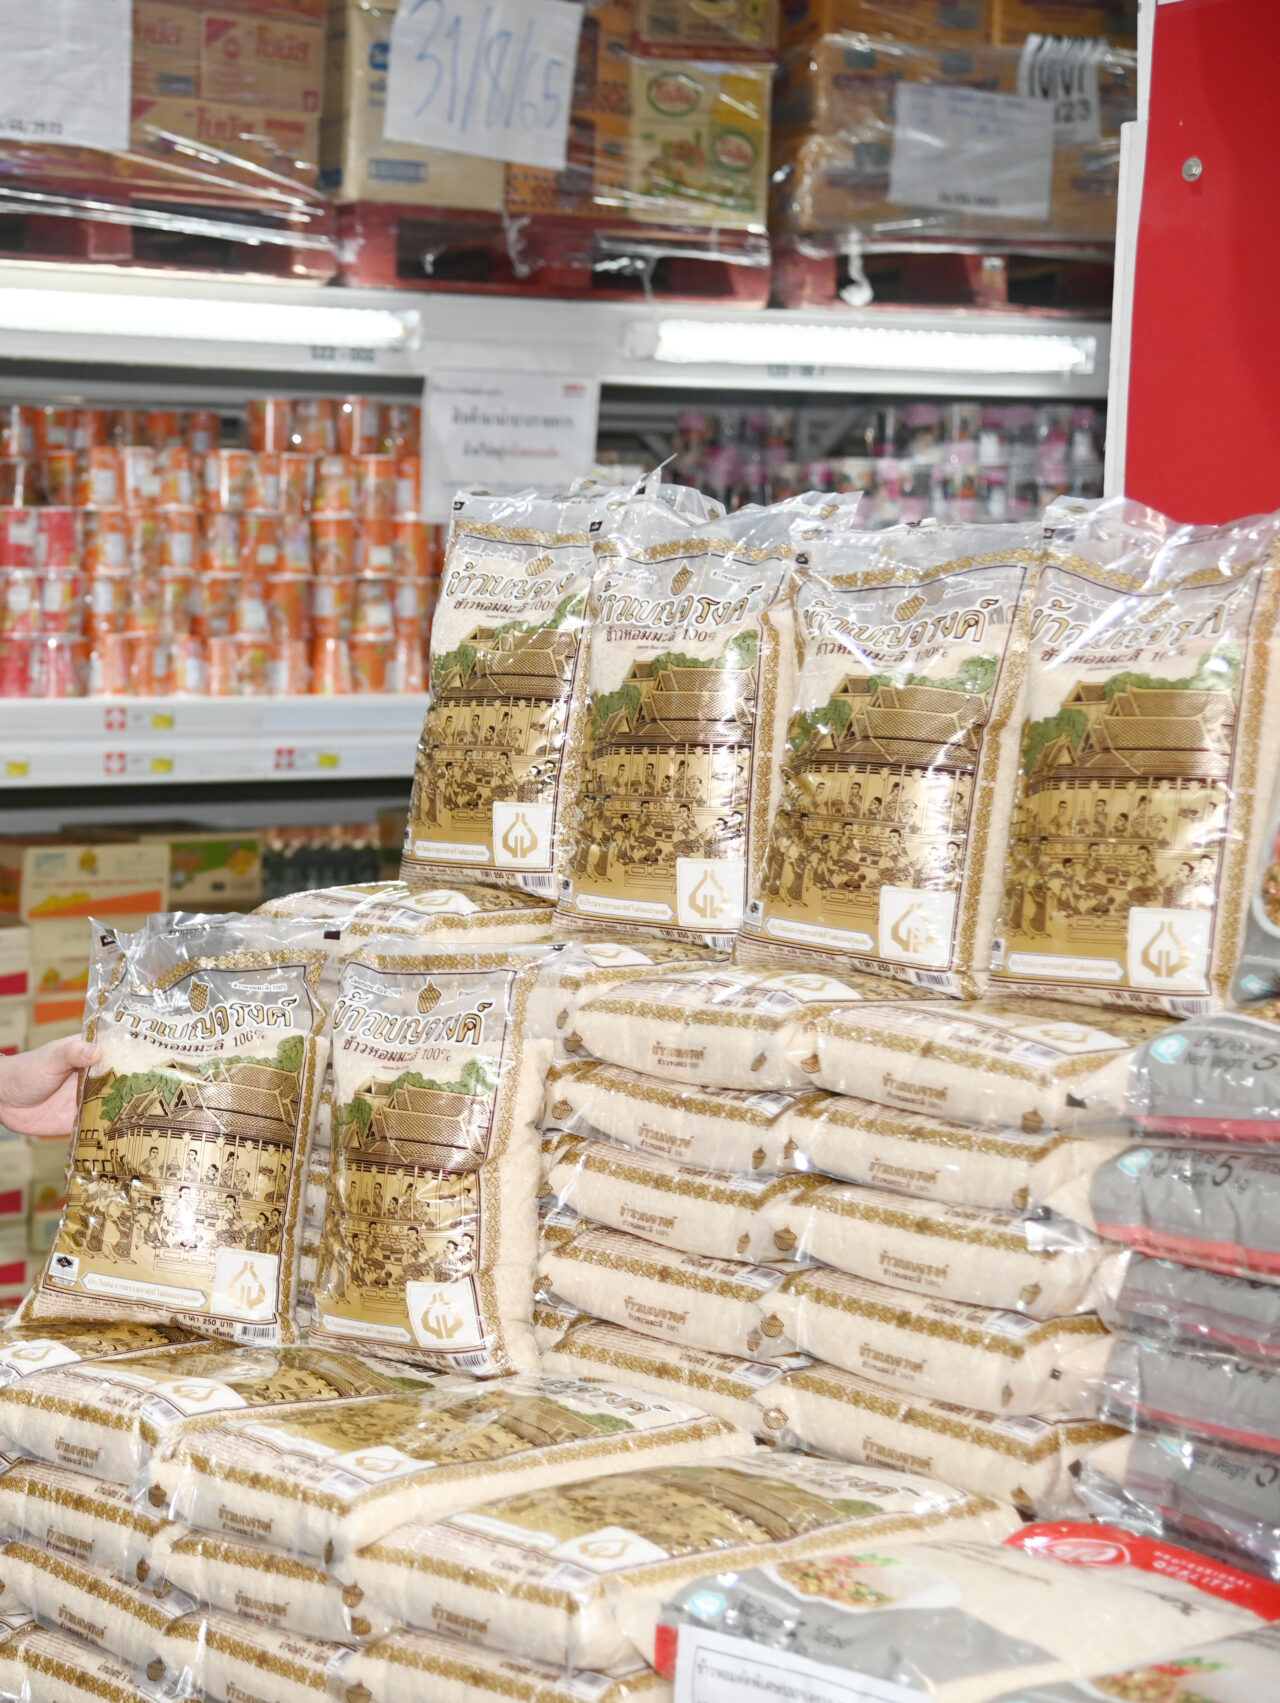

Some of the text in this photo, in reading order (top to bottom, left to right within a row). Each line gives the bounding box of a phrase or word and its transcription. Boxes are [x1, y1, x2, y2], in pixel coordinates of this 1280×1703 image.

[421, 1047, 453, 1062] 100%
[1212, 1155, 1241, 1187] 5
[203, 1317, 216, 1326] 250
[220, 1319, 233, 1329] บาท
[1152, 1560, 1235, 1591] QUALITY
[1153, 1551, 1252, 1589] PROFESSIONAL
